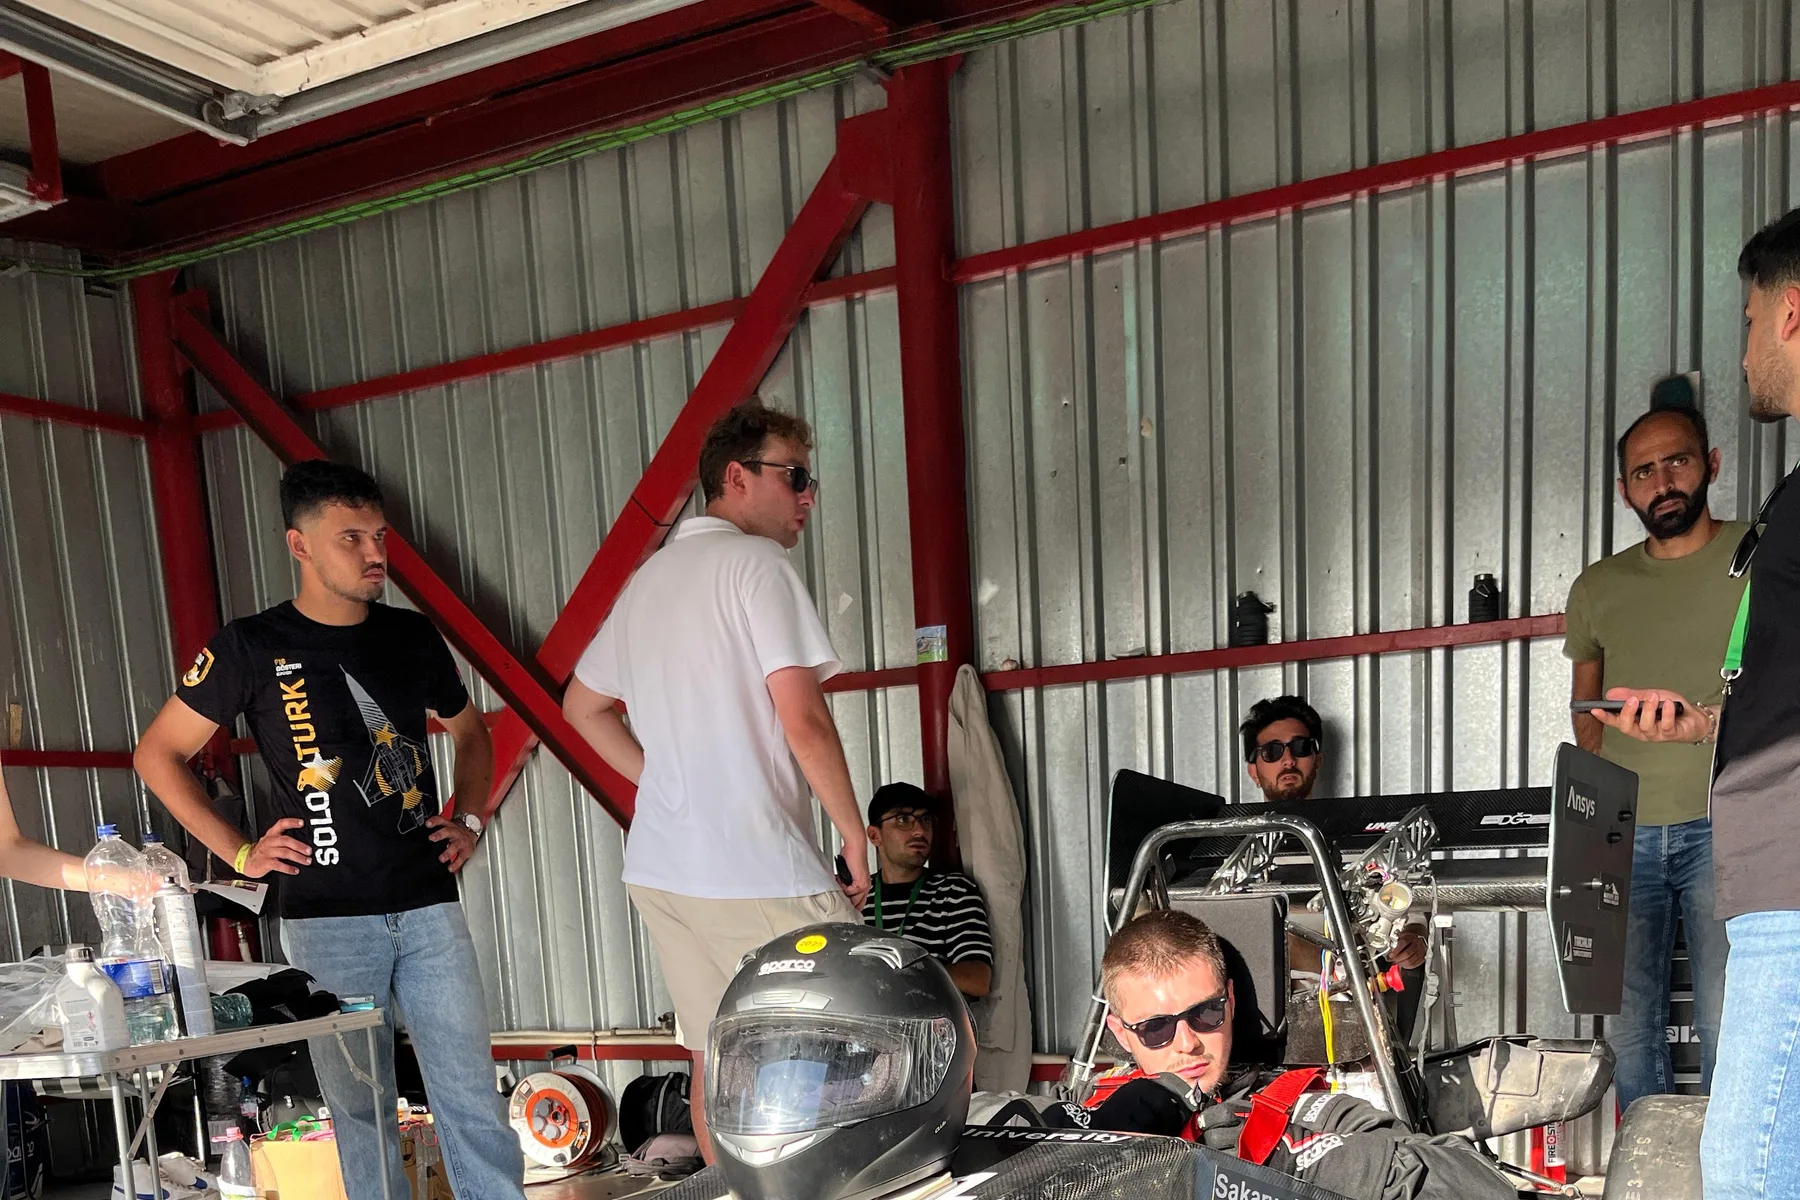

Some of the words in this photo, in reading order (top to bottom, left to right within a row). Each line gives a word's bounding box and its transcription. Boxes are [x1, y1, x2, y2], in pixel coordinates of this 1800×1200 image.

[1567, 785, 1595, 820] Ansys
[305, 791, 340, 866] SOLO
[758, 959, 816, 976] sparco
[1296, 1136, 1342, 1168] sparco
